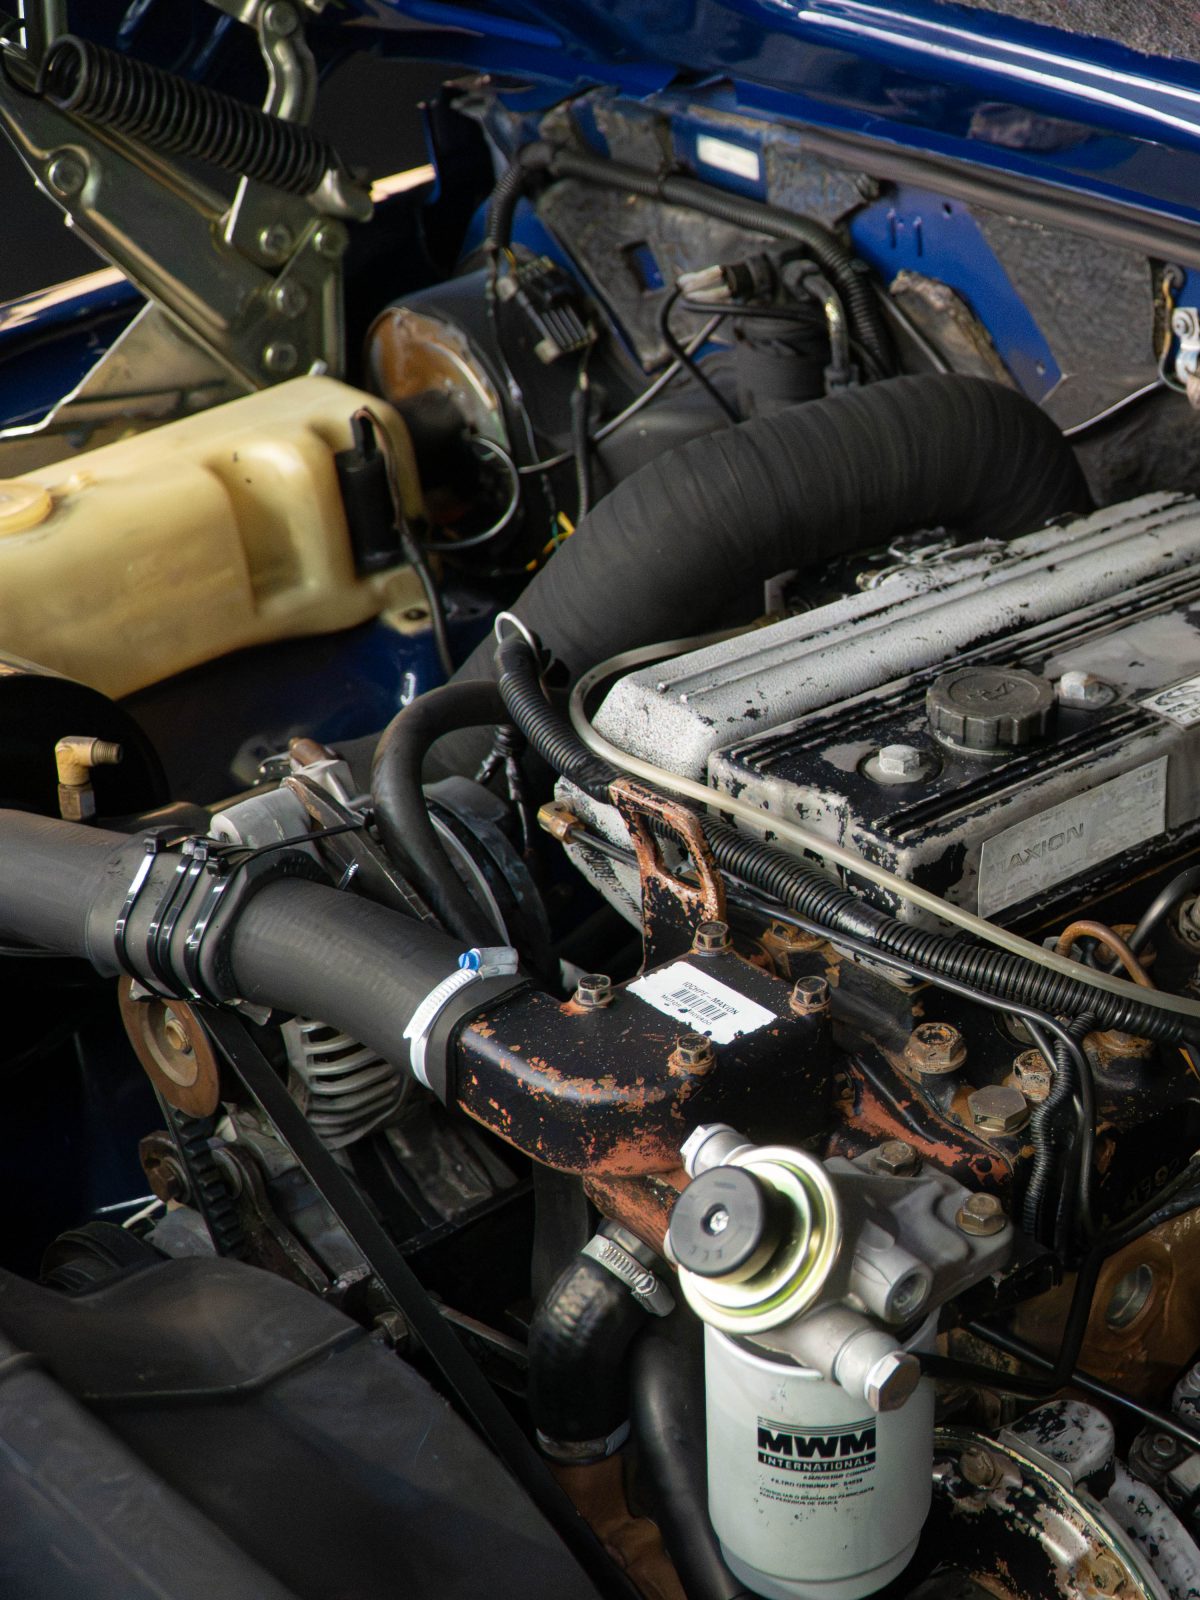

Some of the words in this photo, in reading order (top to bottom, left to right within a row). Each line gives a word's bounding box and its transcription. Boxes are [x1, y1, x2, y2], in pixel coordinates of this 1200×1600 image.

[998, 822, 1084, 872] AXION
[757, 1427, 876, 1458] MWM
[763, 1454, 870, 1472] INTERNATIONAL
